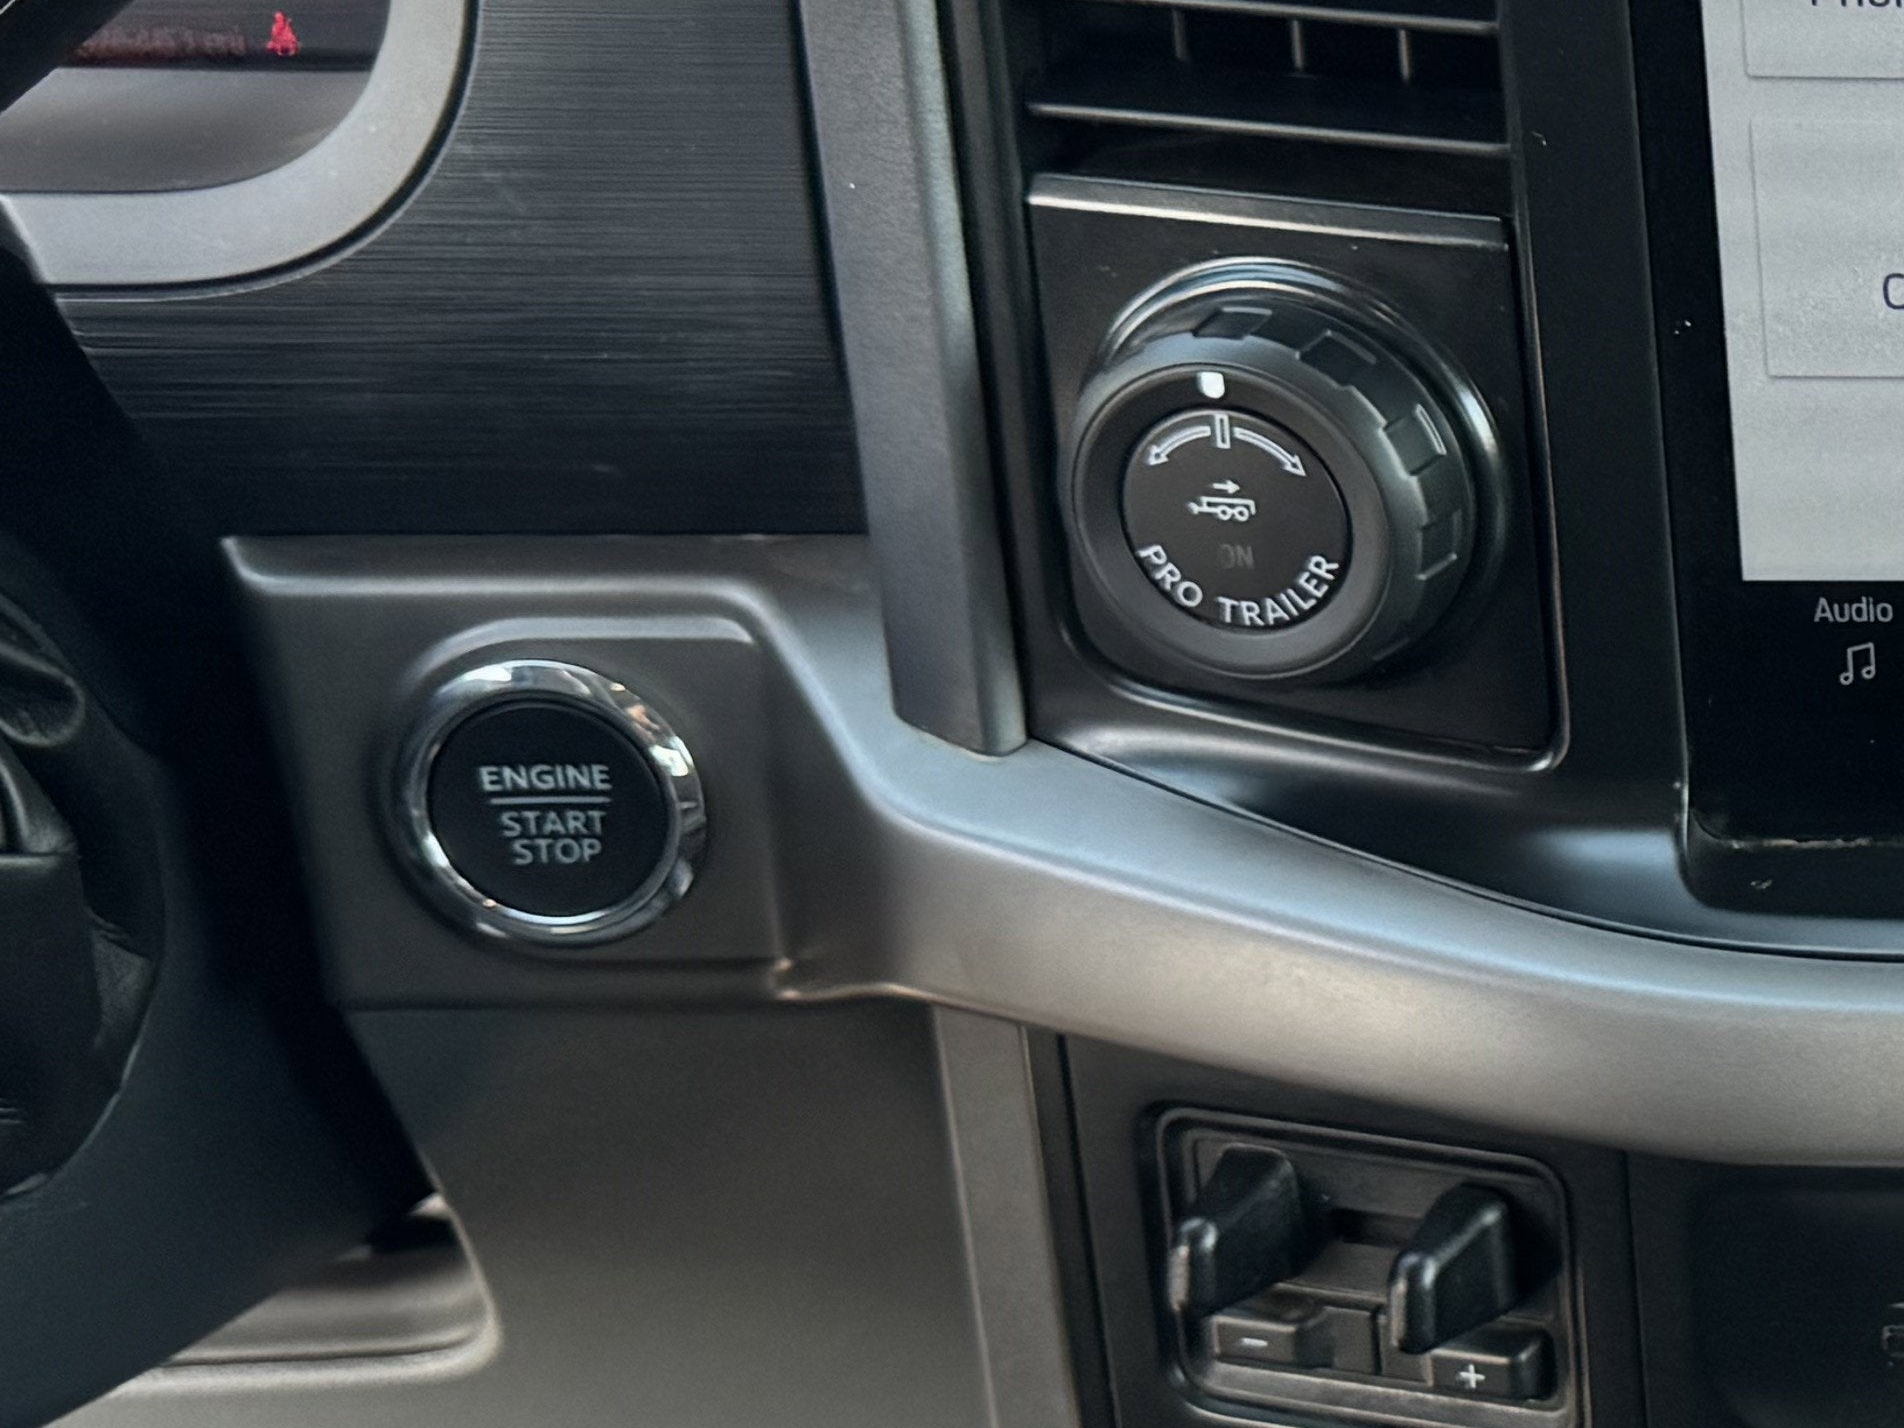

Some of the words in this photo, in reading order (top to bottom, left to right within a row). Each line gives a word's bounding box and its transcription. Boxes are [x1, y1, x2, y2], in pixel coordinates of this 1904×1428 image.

[1137, 544, 1203, 608] PRO
[1217, 555, 1340, 627] TRAILER
[1813, 596, 1894, 623] Audio
[480, 764, 611, 792] ENGINE
[501, 810, 606, 837] START
[511, 839, 602, 865] STOP
